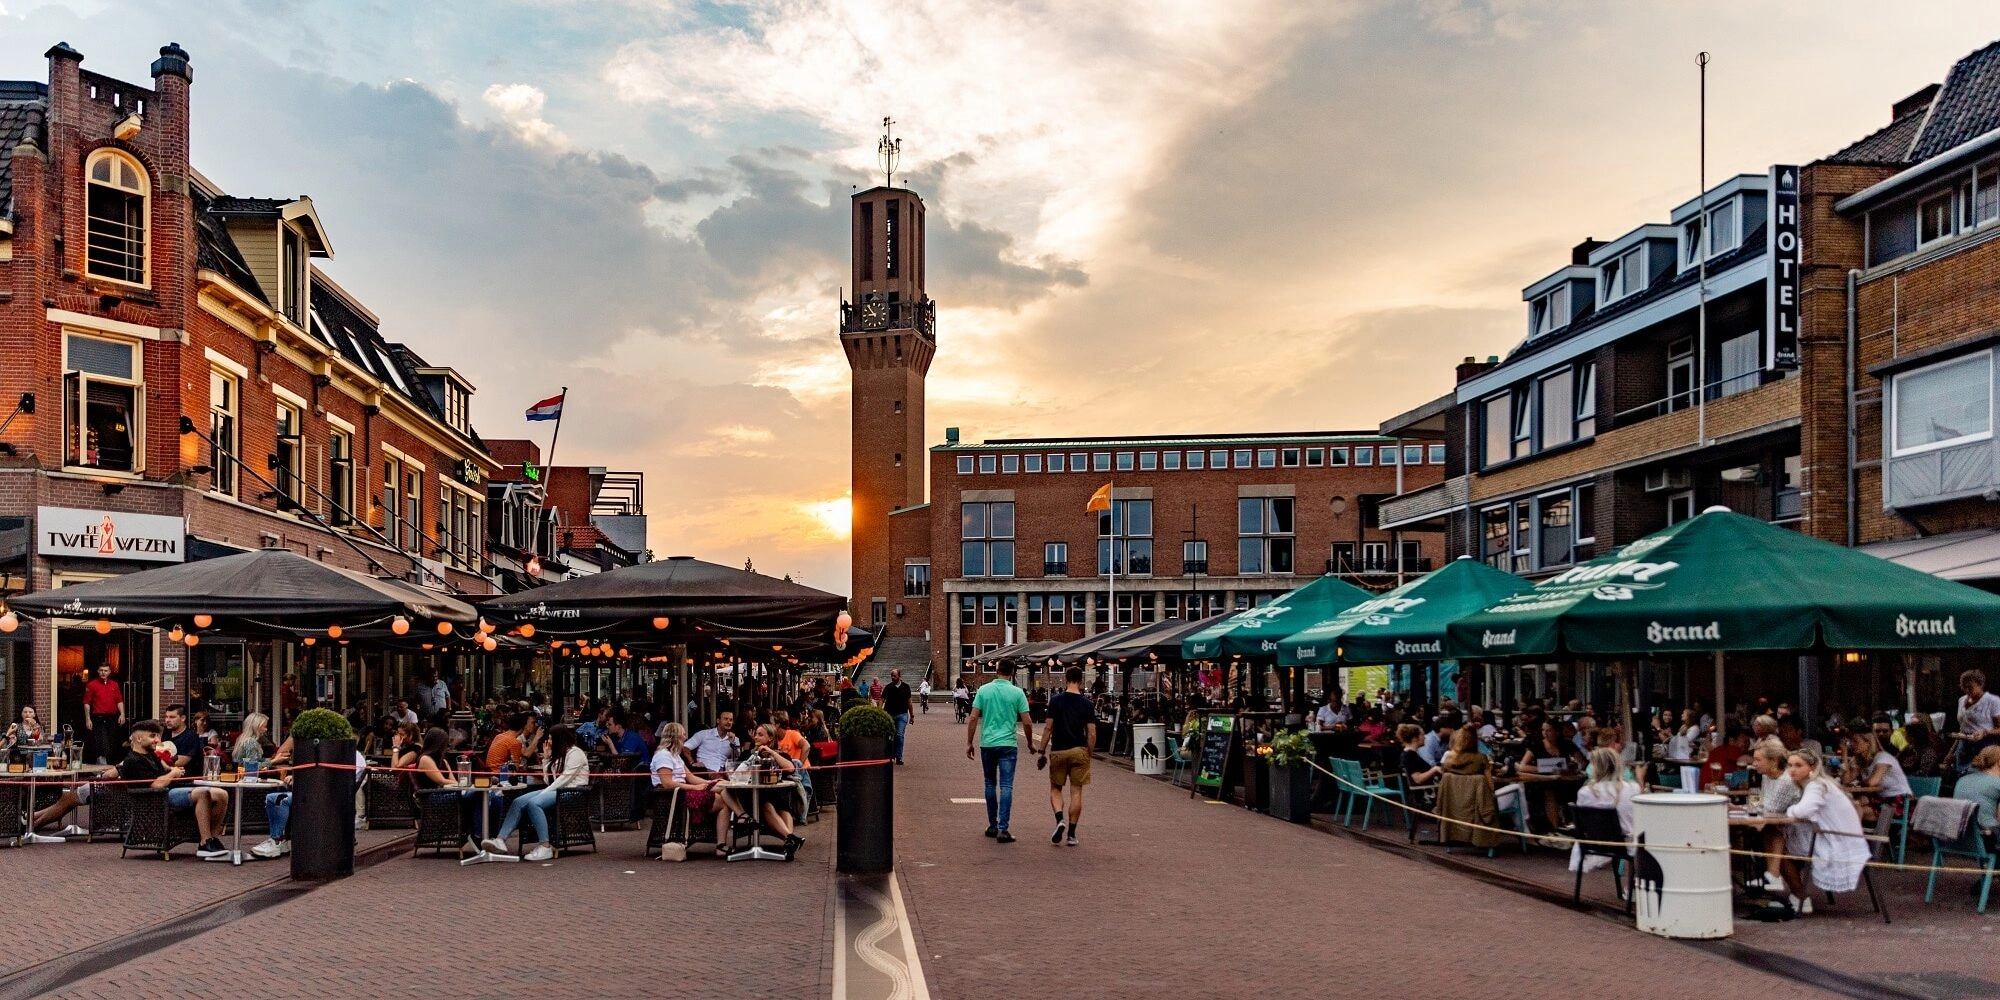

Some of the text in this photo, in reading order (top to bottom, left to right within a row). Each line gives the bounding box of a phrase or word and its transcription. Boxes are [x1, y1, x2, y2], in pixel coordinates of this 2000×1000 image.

[1778, 204, 1796, 332] HOTEL
[86, 525, 99, 535] DE
[48, 532, 176, 554] TWEE WEZEN
[1647, 620, 1721, 644] Brand
[1895, 613, 1956, 638] Brand
[1395, 639, 1442, 655] Brand
[1482, 628, 1516, 648] Brand
